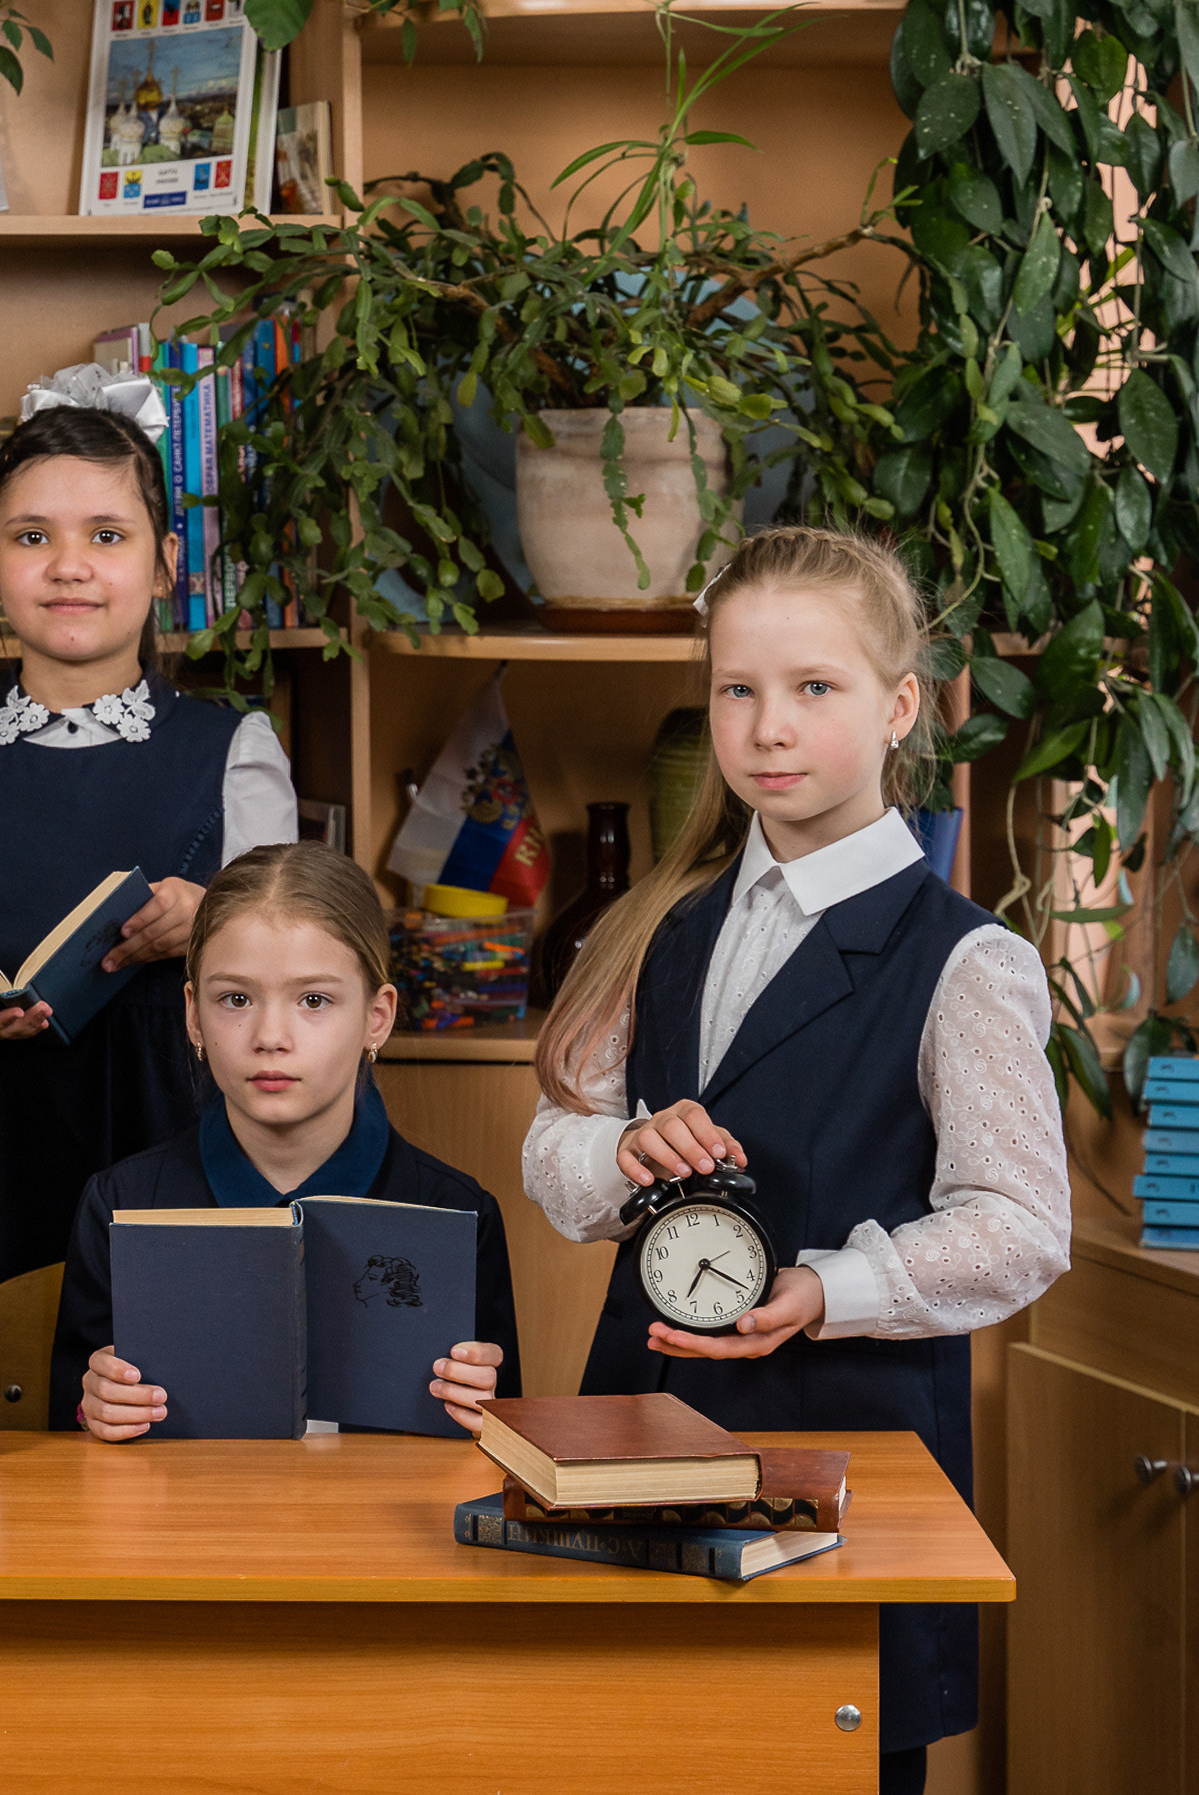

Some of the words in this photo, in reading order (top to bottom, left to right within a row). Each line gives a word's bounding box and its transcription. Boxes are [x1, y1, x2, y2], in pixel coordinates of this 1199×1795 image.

[203, 383, 214, 455] МАТЕМАТИКА
[172, 386, 185, 474] САНКТ-ПЕТЕРБУЕ
[685, 1212, 700, 1227] 12
[713, 1214, 720, 1227] 1
[666, 1225, 680, 1241] 11
[733, 1224, 743, 1238] 2
[655, 1246, 669, 1261] 10
[747, 1245, 757, 1259] 3
[653, 1269, 663, 1283] 9
[746, 1269, 755, 1282] 4
[667, 1289, 678, 1303] 8
[735, 1289, 744, 1304] 5
[689, 1300, 698, 1314] 7
[713, 1301, 723, 1315] 6
